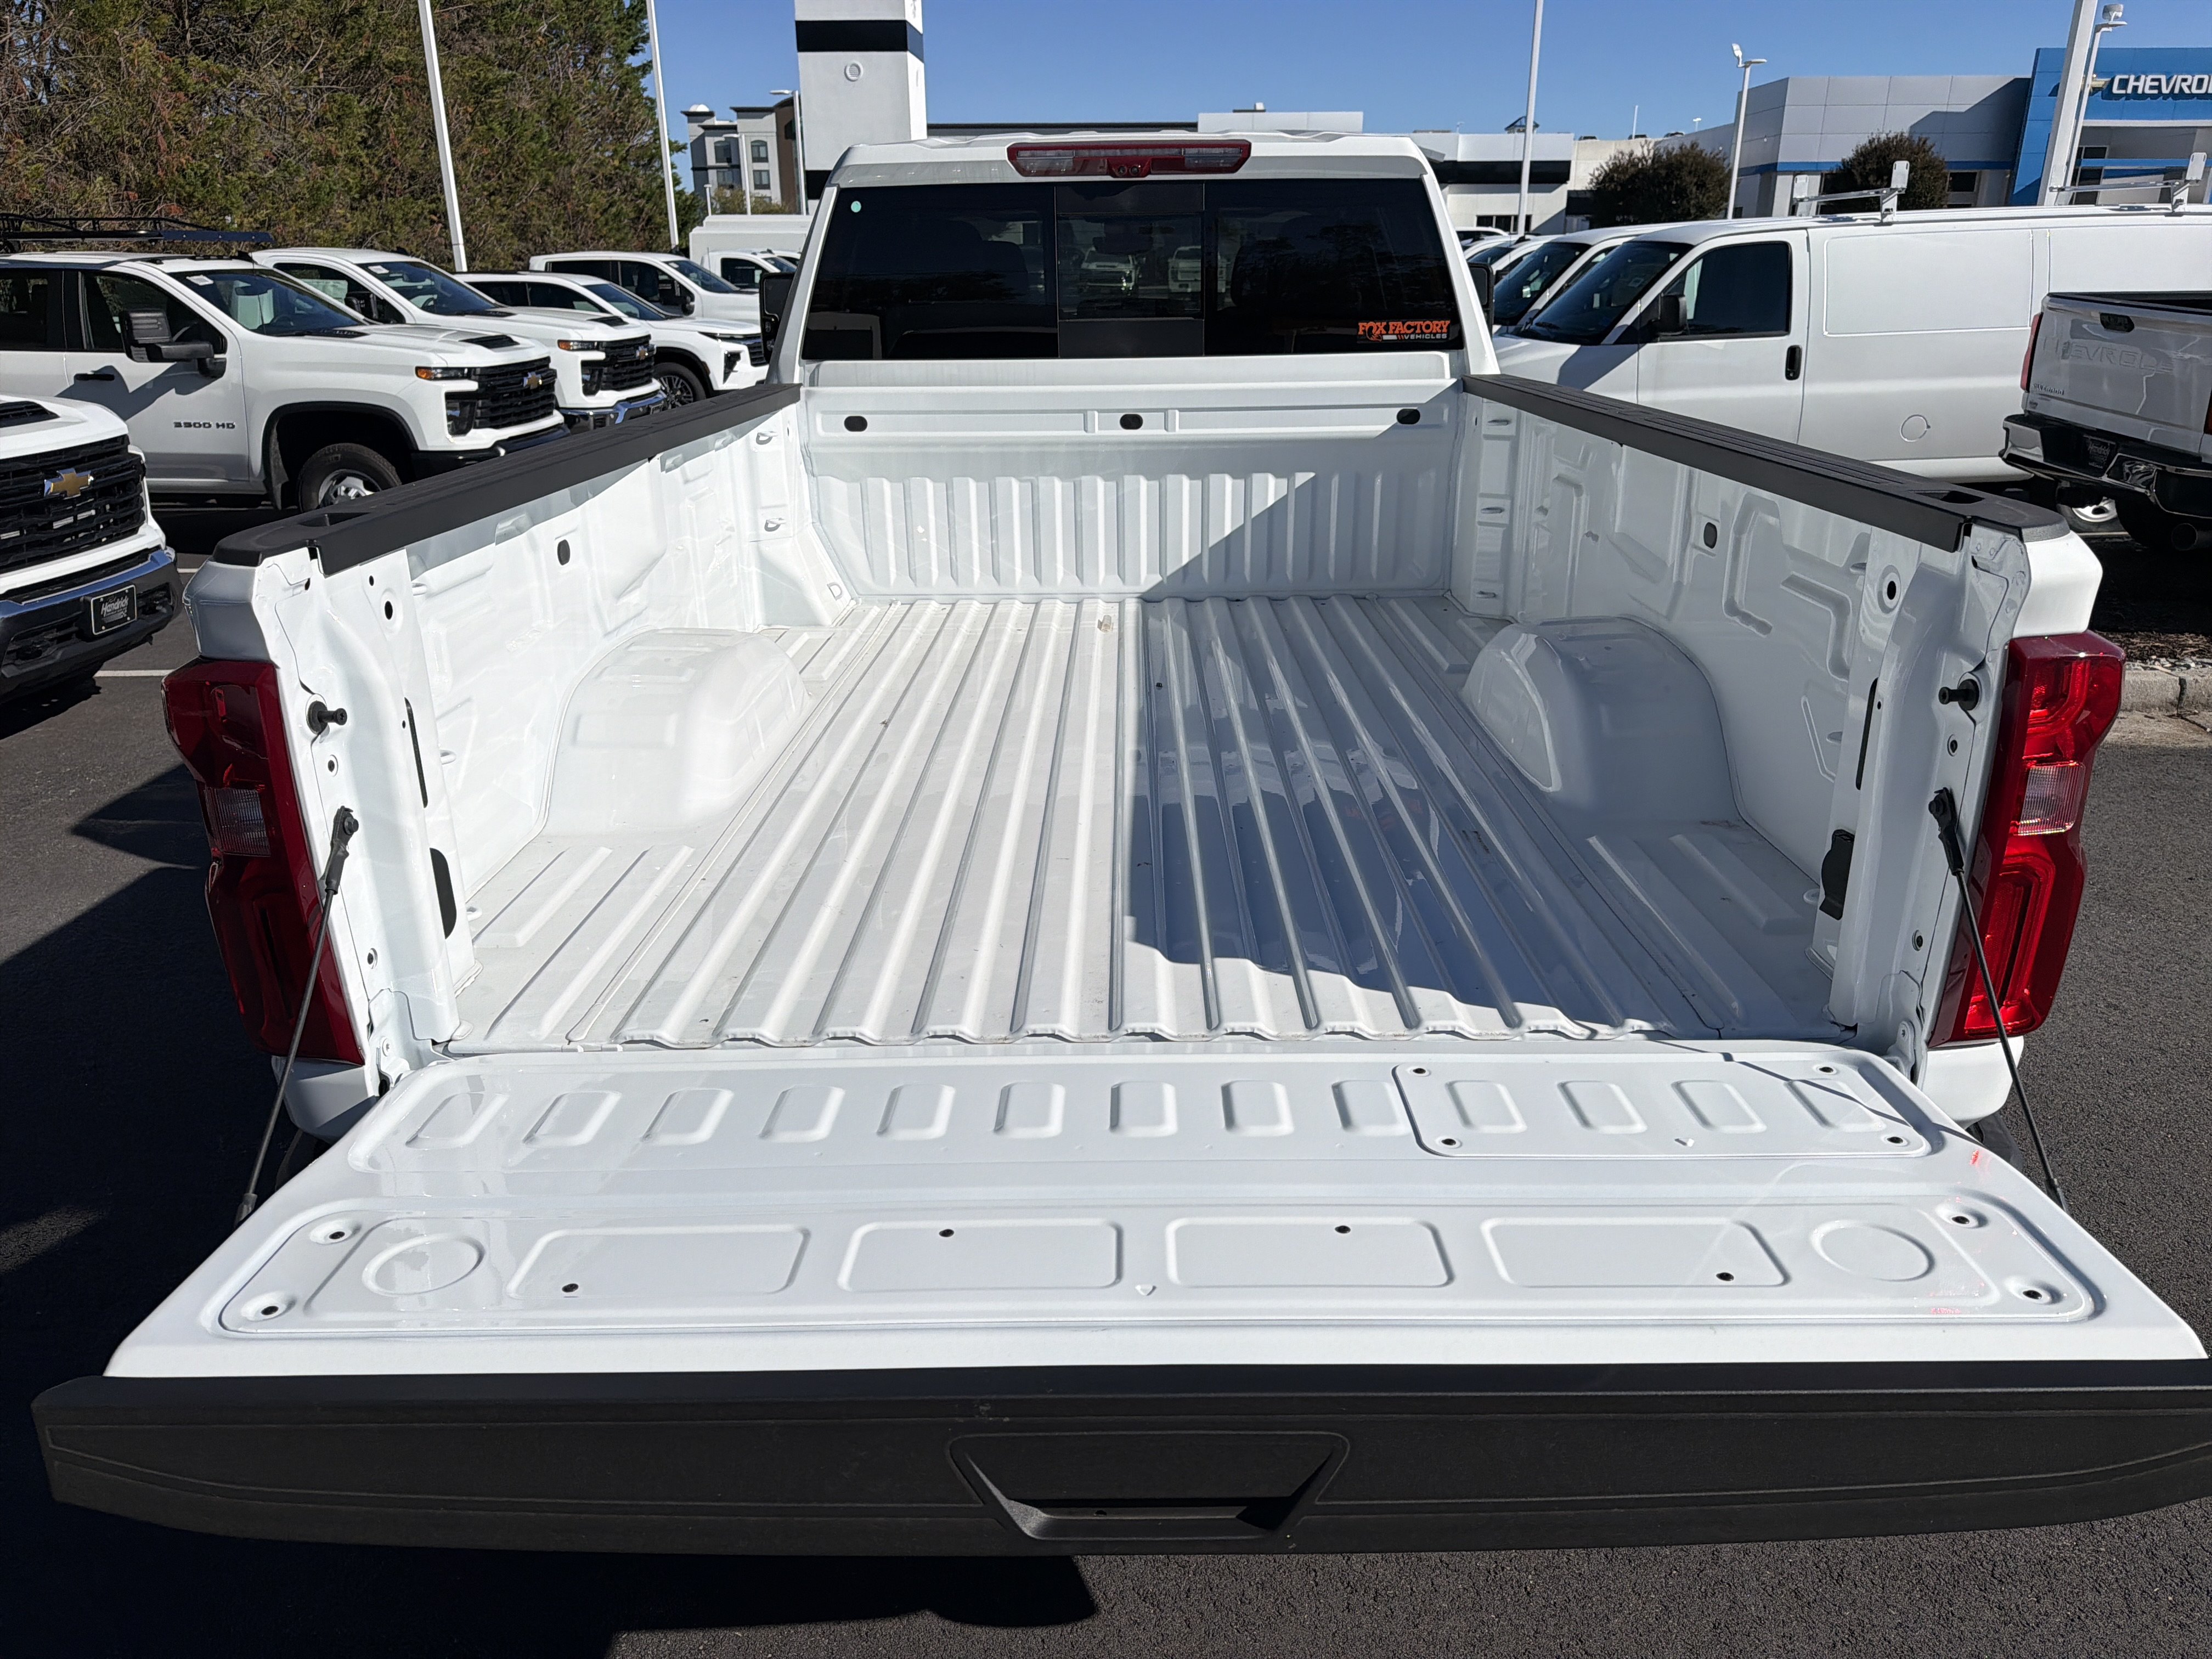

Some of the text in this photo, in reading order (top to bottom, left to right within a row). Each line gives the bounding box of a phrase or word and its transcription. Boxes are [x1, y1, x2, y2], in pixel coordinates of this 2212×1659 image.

[1358, 320, 1451, 336] FOX FACTORY
[100, 595, 129, 618] Hendrick
